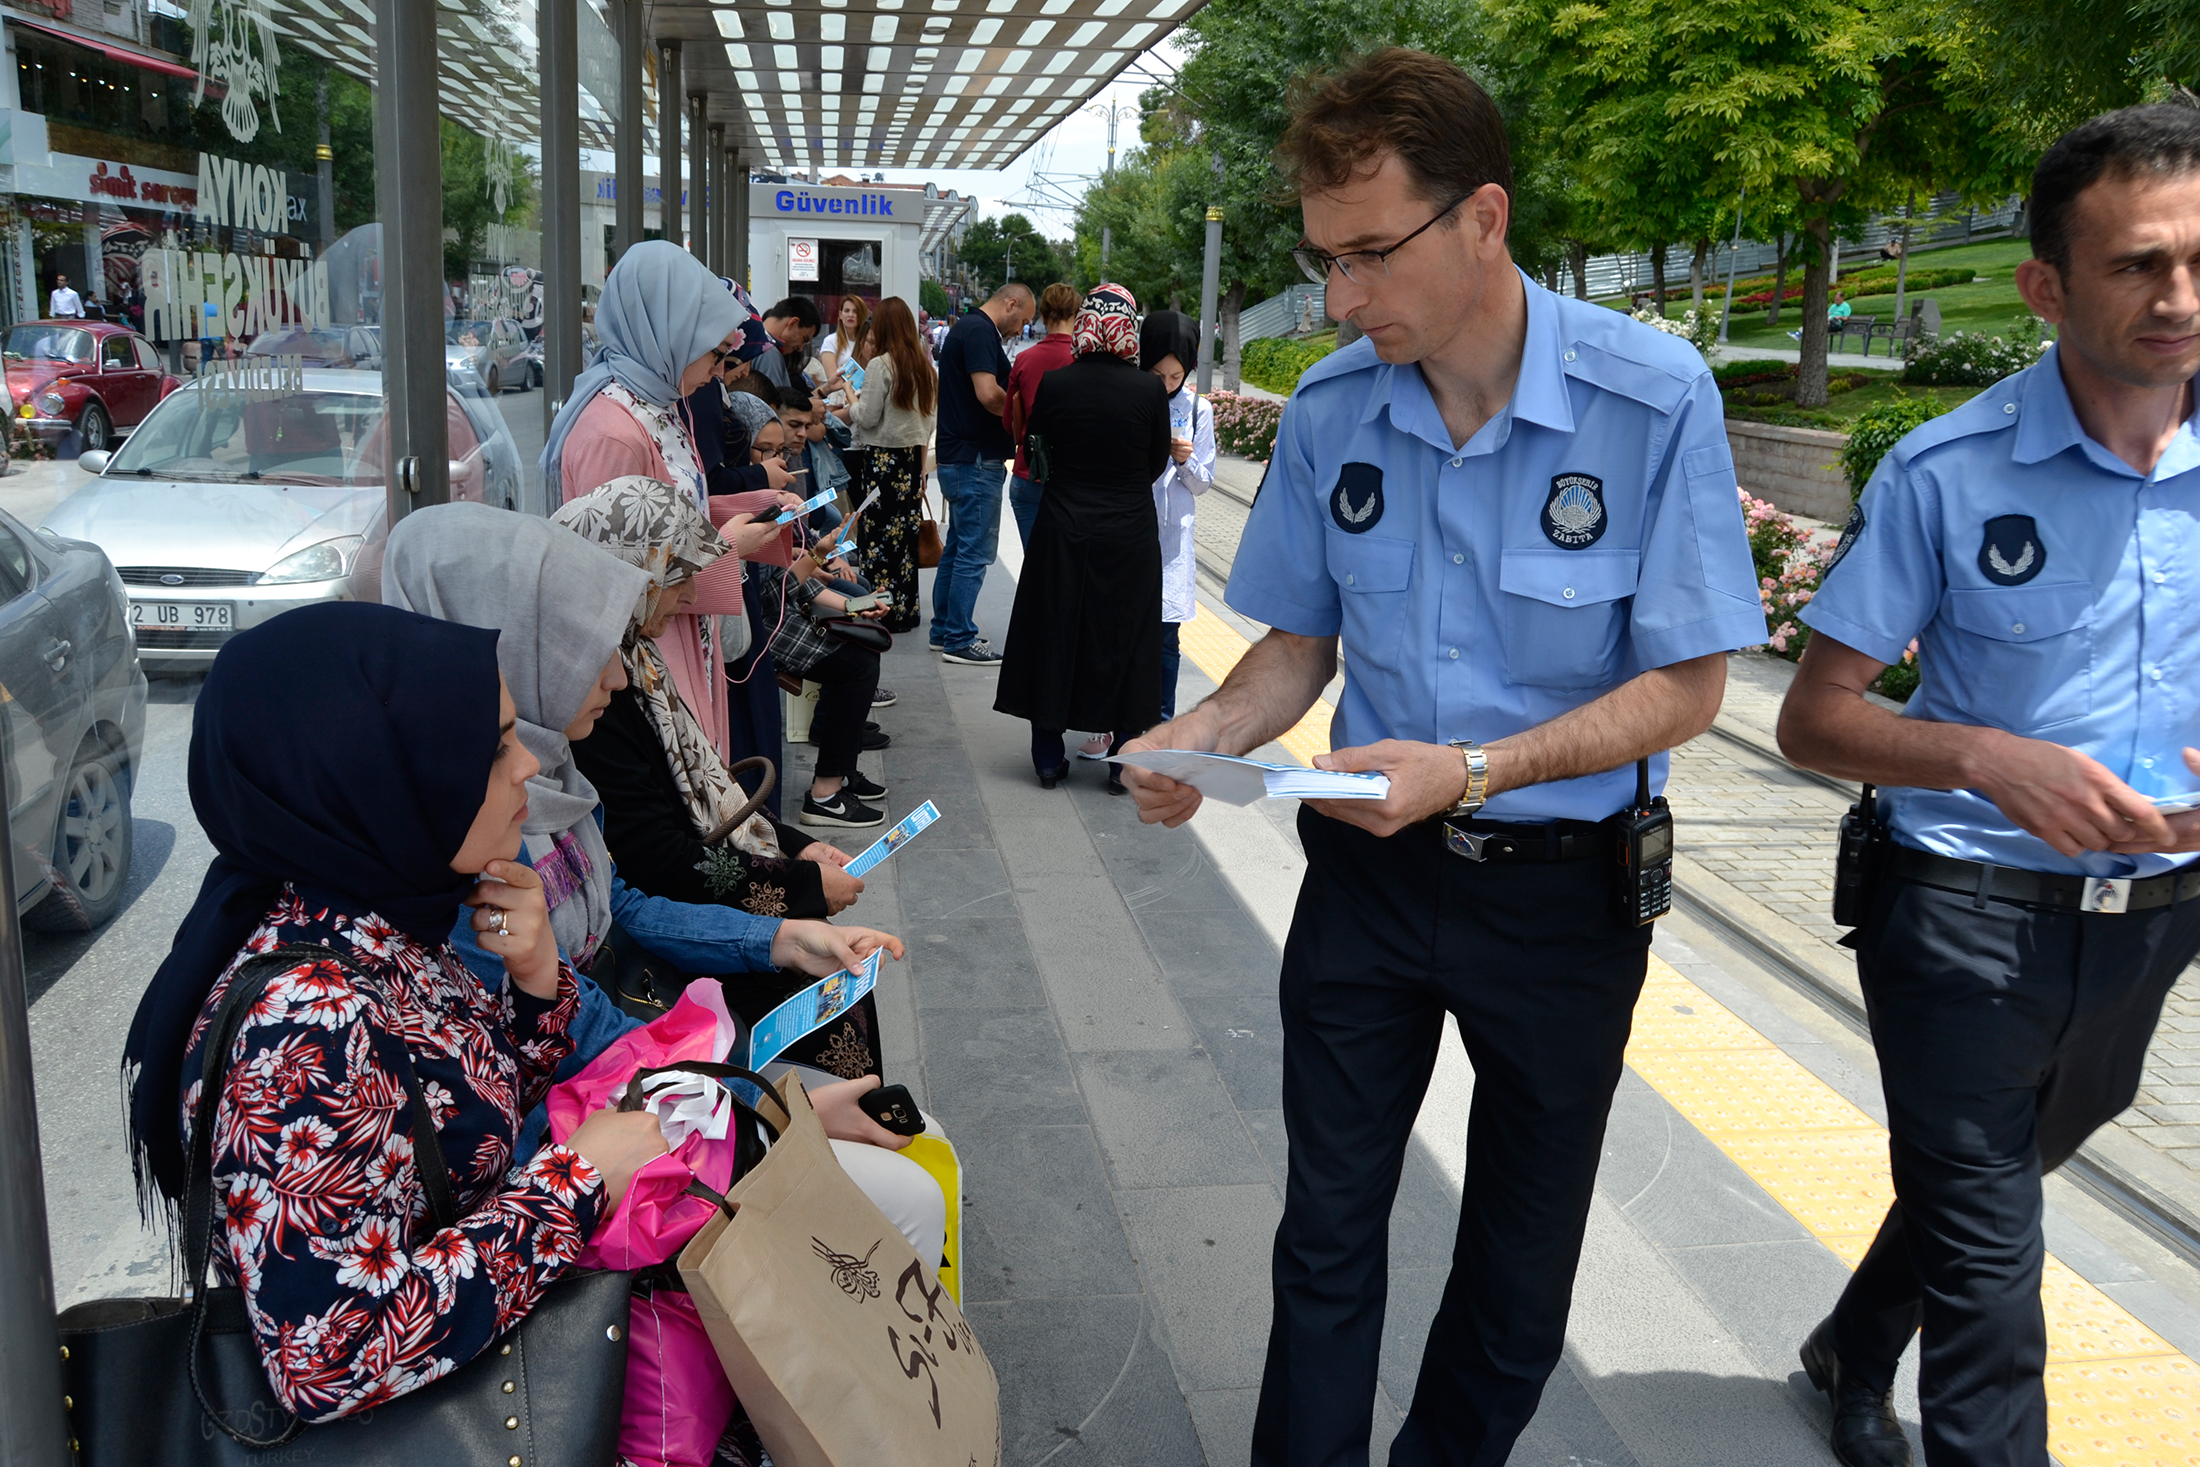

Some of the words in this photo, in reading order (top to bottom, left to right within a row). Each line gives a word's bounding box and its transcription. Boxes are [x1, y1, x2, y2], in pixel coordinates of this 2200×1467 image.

[90, 162, 137, 199] simit
[776, 190, 894, 216] Güvenlik
[1552, 529, 1594, 544] ZABITA
[157, 606, 179, 623] UB
[194, 607, 229, 624] 978
[244, 1448, 316, 1467] TURKEY
